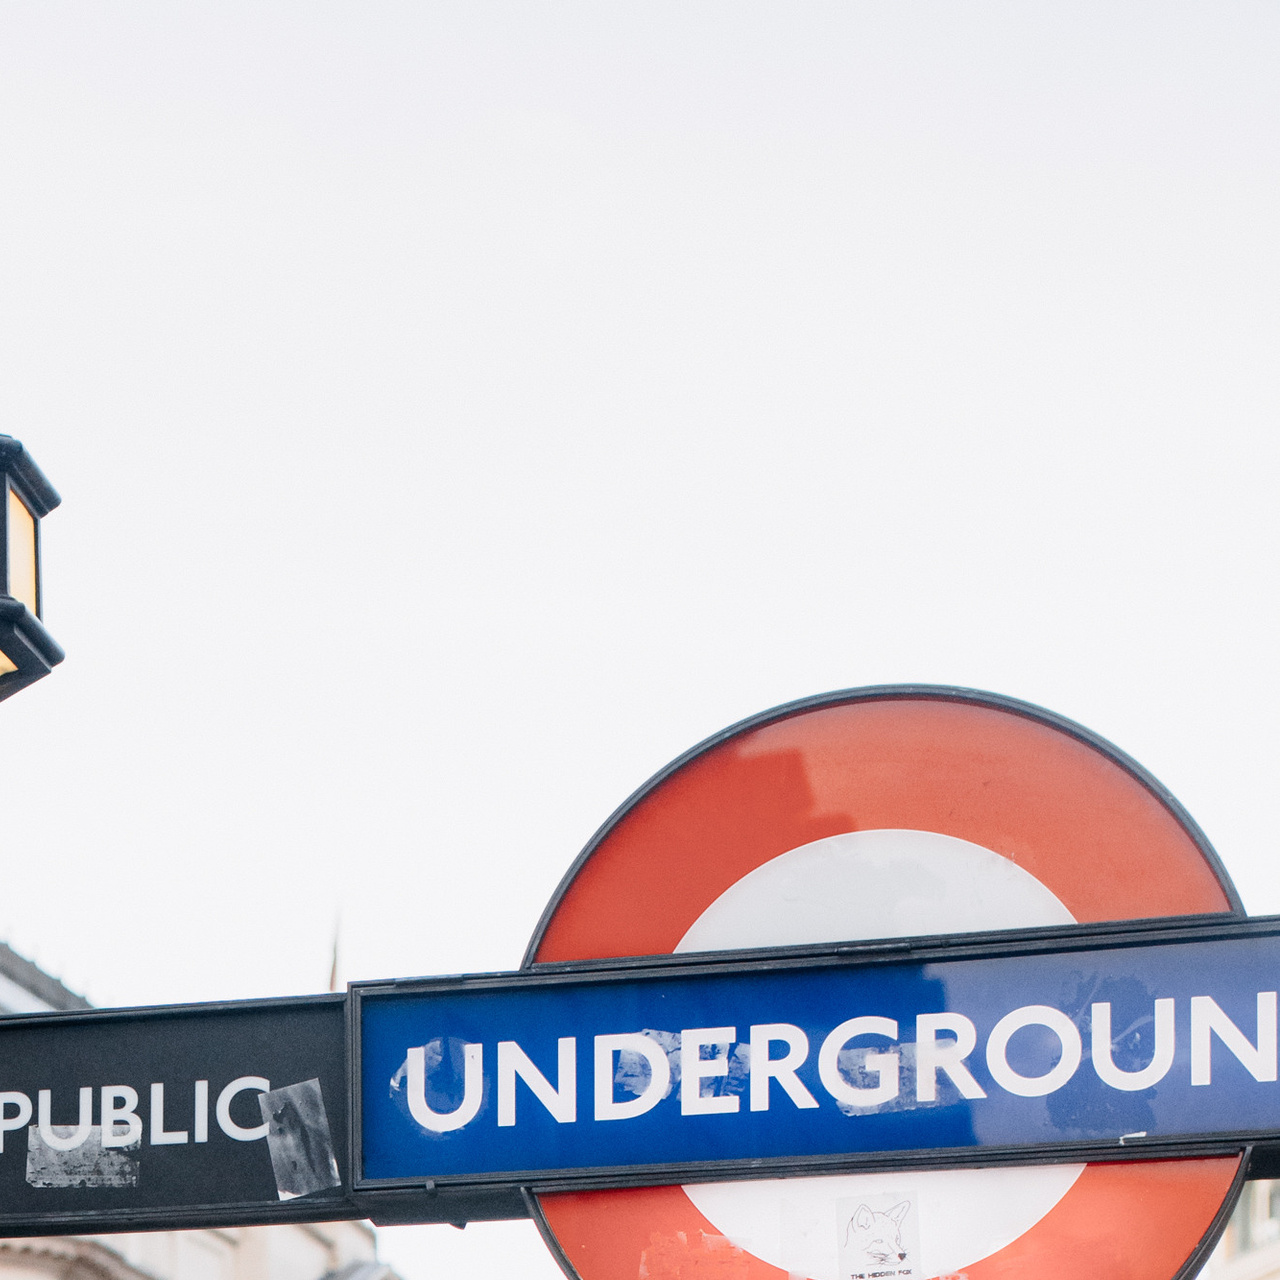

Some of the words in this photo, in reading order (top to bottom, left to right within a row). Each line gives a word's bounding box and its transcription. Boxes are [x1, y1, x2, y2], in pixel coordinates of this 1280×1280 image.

[406, 990, 1278, 1133] UNDERGROUN
[867, 1270, 896, 1279] HIDDEN
[898, 1268, 912, 1276] FOX
